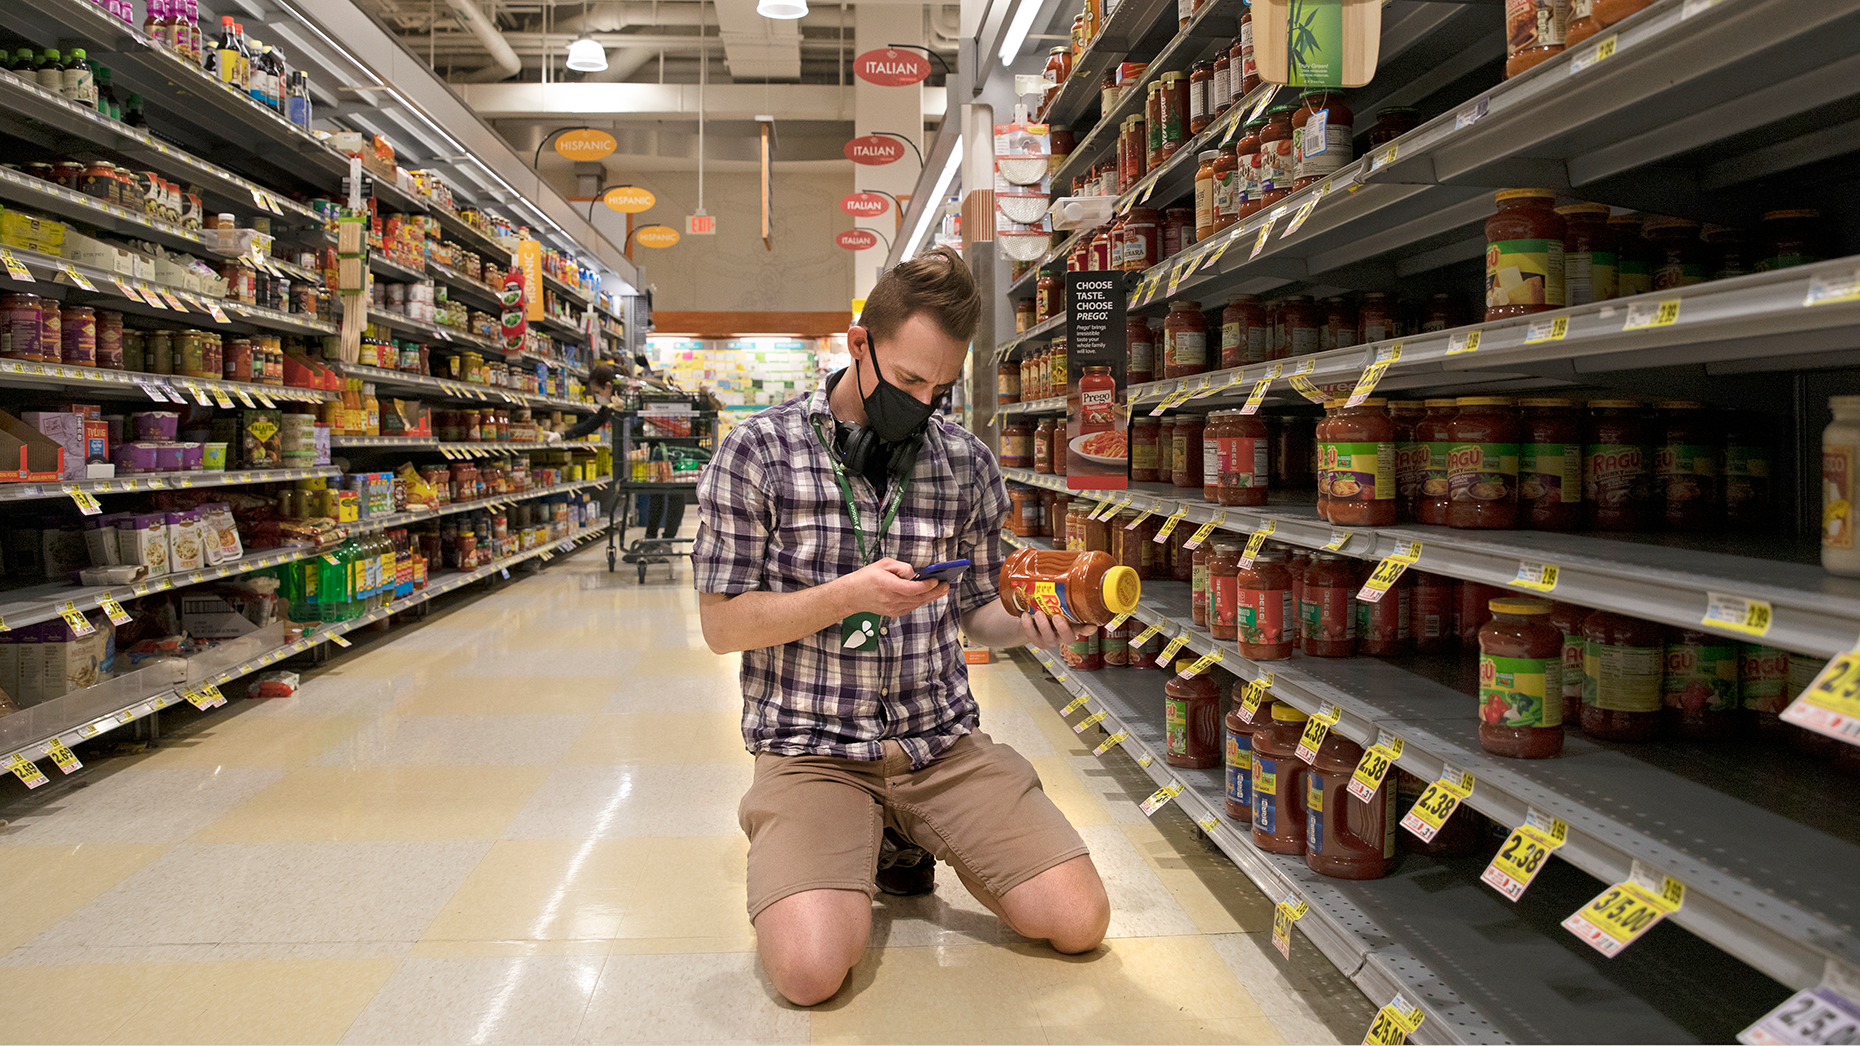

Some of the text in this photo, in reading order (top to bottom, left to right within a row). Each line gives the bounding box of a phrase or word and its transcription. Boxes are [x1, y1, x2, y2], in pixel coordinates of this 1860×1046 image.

[866, 61, 918, 75] ITALIAN
[560, 140, 611, 151] HISPANIC
[854, 146, 895, 156] ITALIAN
[608, 196, 651, 205] HISPANIC
[847, 201, 882, 210] ITALIAN
[691, 217, 711, 233] EXIT
[640, 233, 676, 241] HISPANIC
[841, 237, 871, 245] ITALIAN
[525, 252, 535, 304] HISPANIC
[1076, 281, 1113, 290] CHOOSE
[1076, 292, 1106, 300] TASTE.
[1076, 302, 1113, 310] CHOOSE
[1083, 393, 1110, 404] Prego
[848, 501, 859, 525] instacart
[1371, 561, 1405, 584] 2.38
[1245, 684, 1262, 708] 2.38
[1304, 718, 1326, 745] 2.38
[52, 747, 73, 764] 2.69
[14, 762, 38, 779] 2.69
[1358, 751, 1388, 782] 2.38
[1361, 790, 1373, 800] .31
[1418, 786, 1457, 821] 2.38
[1500, 834, 1546, 874] 2.38
[1506, 883, 1522, 897] .31
[1592, 890, 1657, 933] 3/5.00
[1371, 1013, 1404, 1045] 2/5.00
